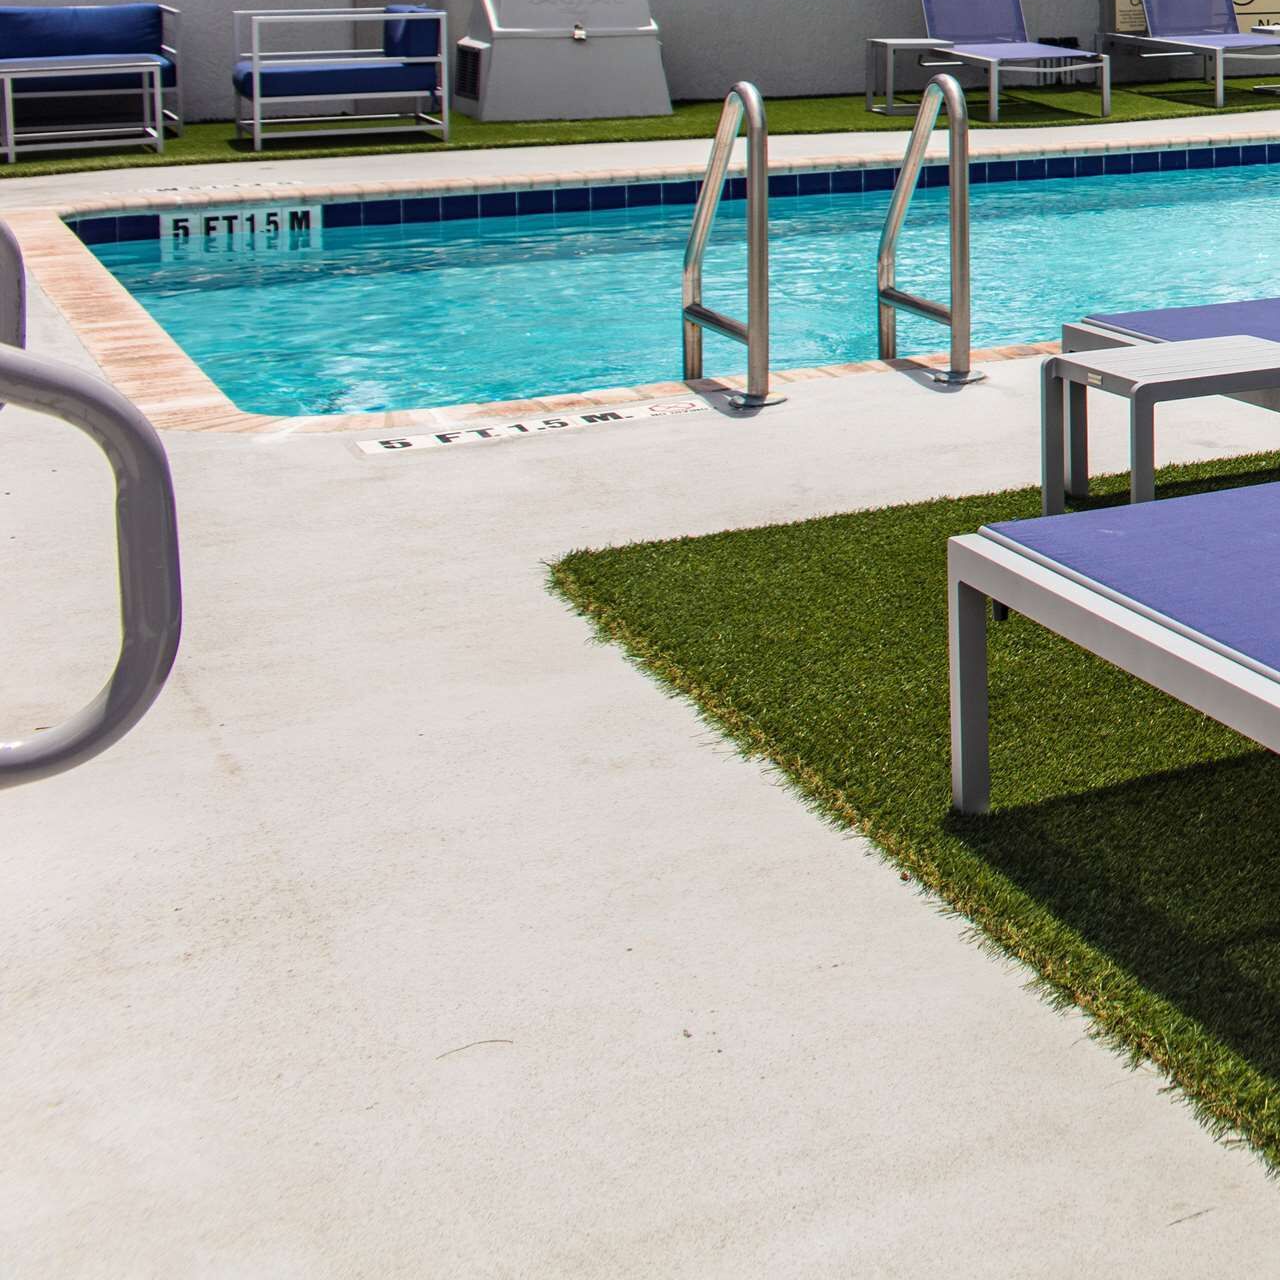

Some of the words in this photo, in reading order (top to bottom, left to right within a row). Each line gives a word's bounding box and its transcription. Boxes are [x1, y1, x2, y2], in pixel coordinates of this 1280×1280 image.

[172, 218, 190, 238] 5
[203, 215, 238, 236] FT
[288, 210, 311, 231] M
[378, 438, 413, 449] 5
[507, 418, 569, 432] 1.5
[580, 412, 634, 423] M.
